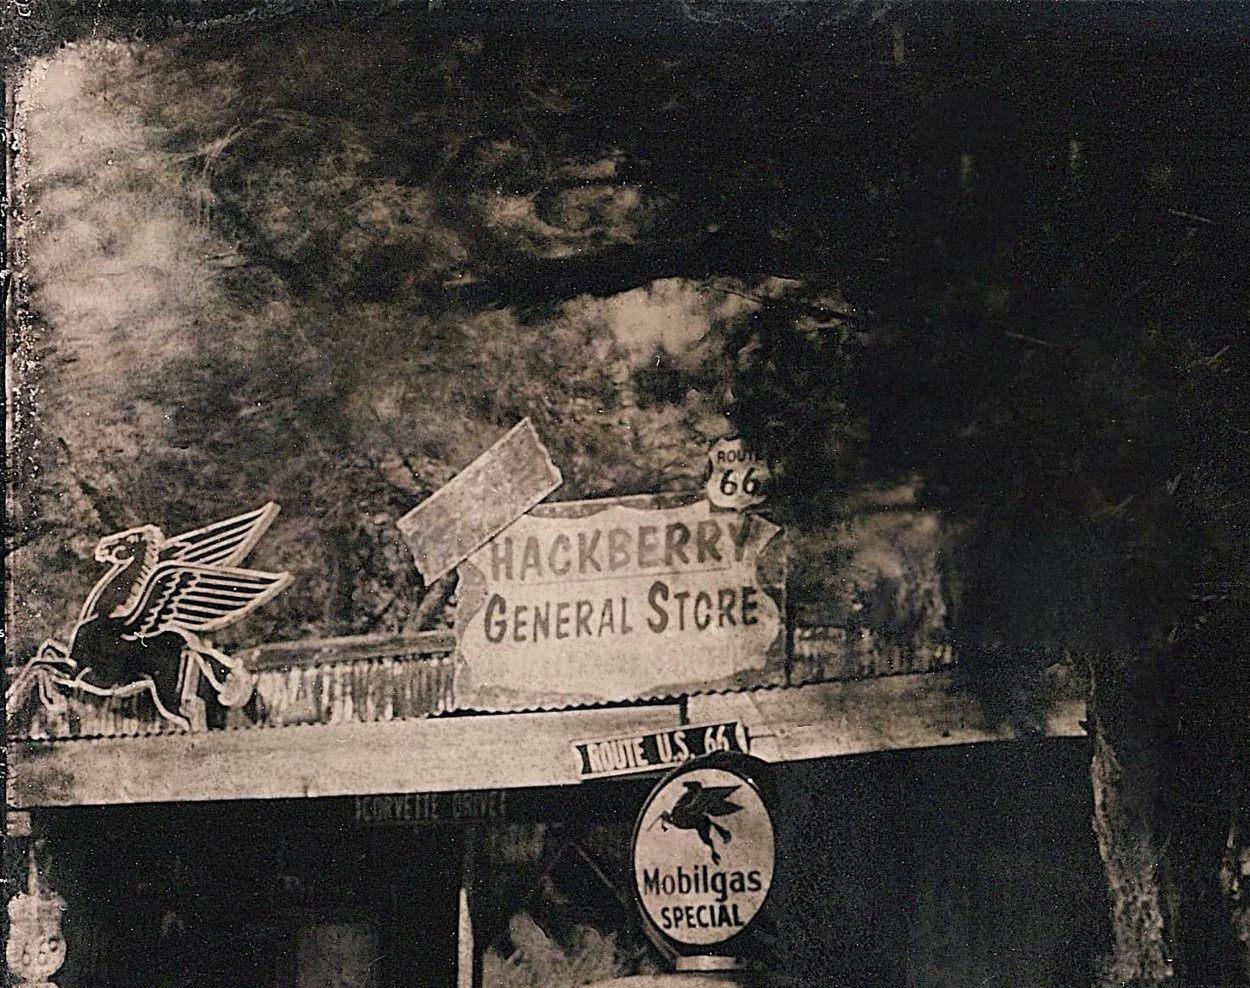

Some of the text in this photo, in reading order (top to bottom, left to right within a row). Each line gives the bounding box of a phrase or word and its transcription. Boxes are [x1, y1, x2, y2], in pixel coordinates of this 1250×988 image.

[720, 467, 761, 496] 66
[491, 513, 757, 582] HACKBERRY
[483, 580, 759, 644] GENERAL STORE
[587, 725, 730, 773] ROUTE U.S. 66
[643, 864, 762, 902] Mobilgas
[661, 903, 745, 929] SPECIAL
